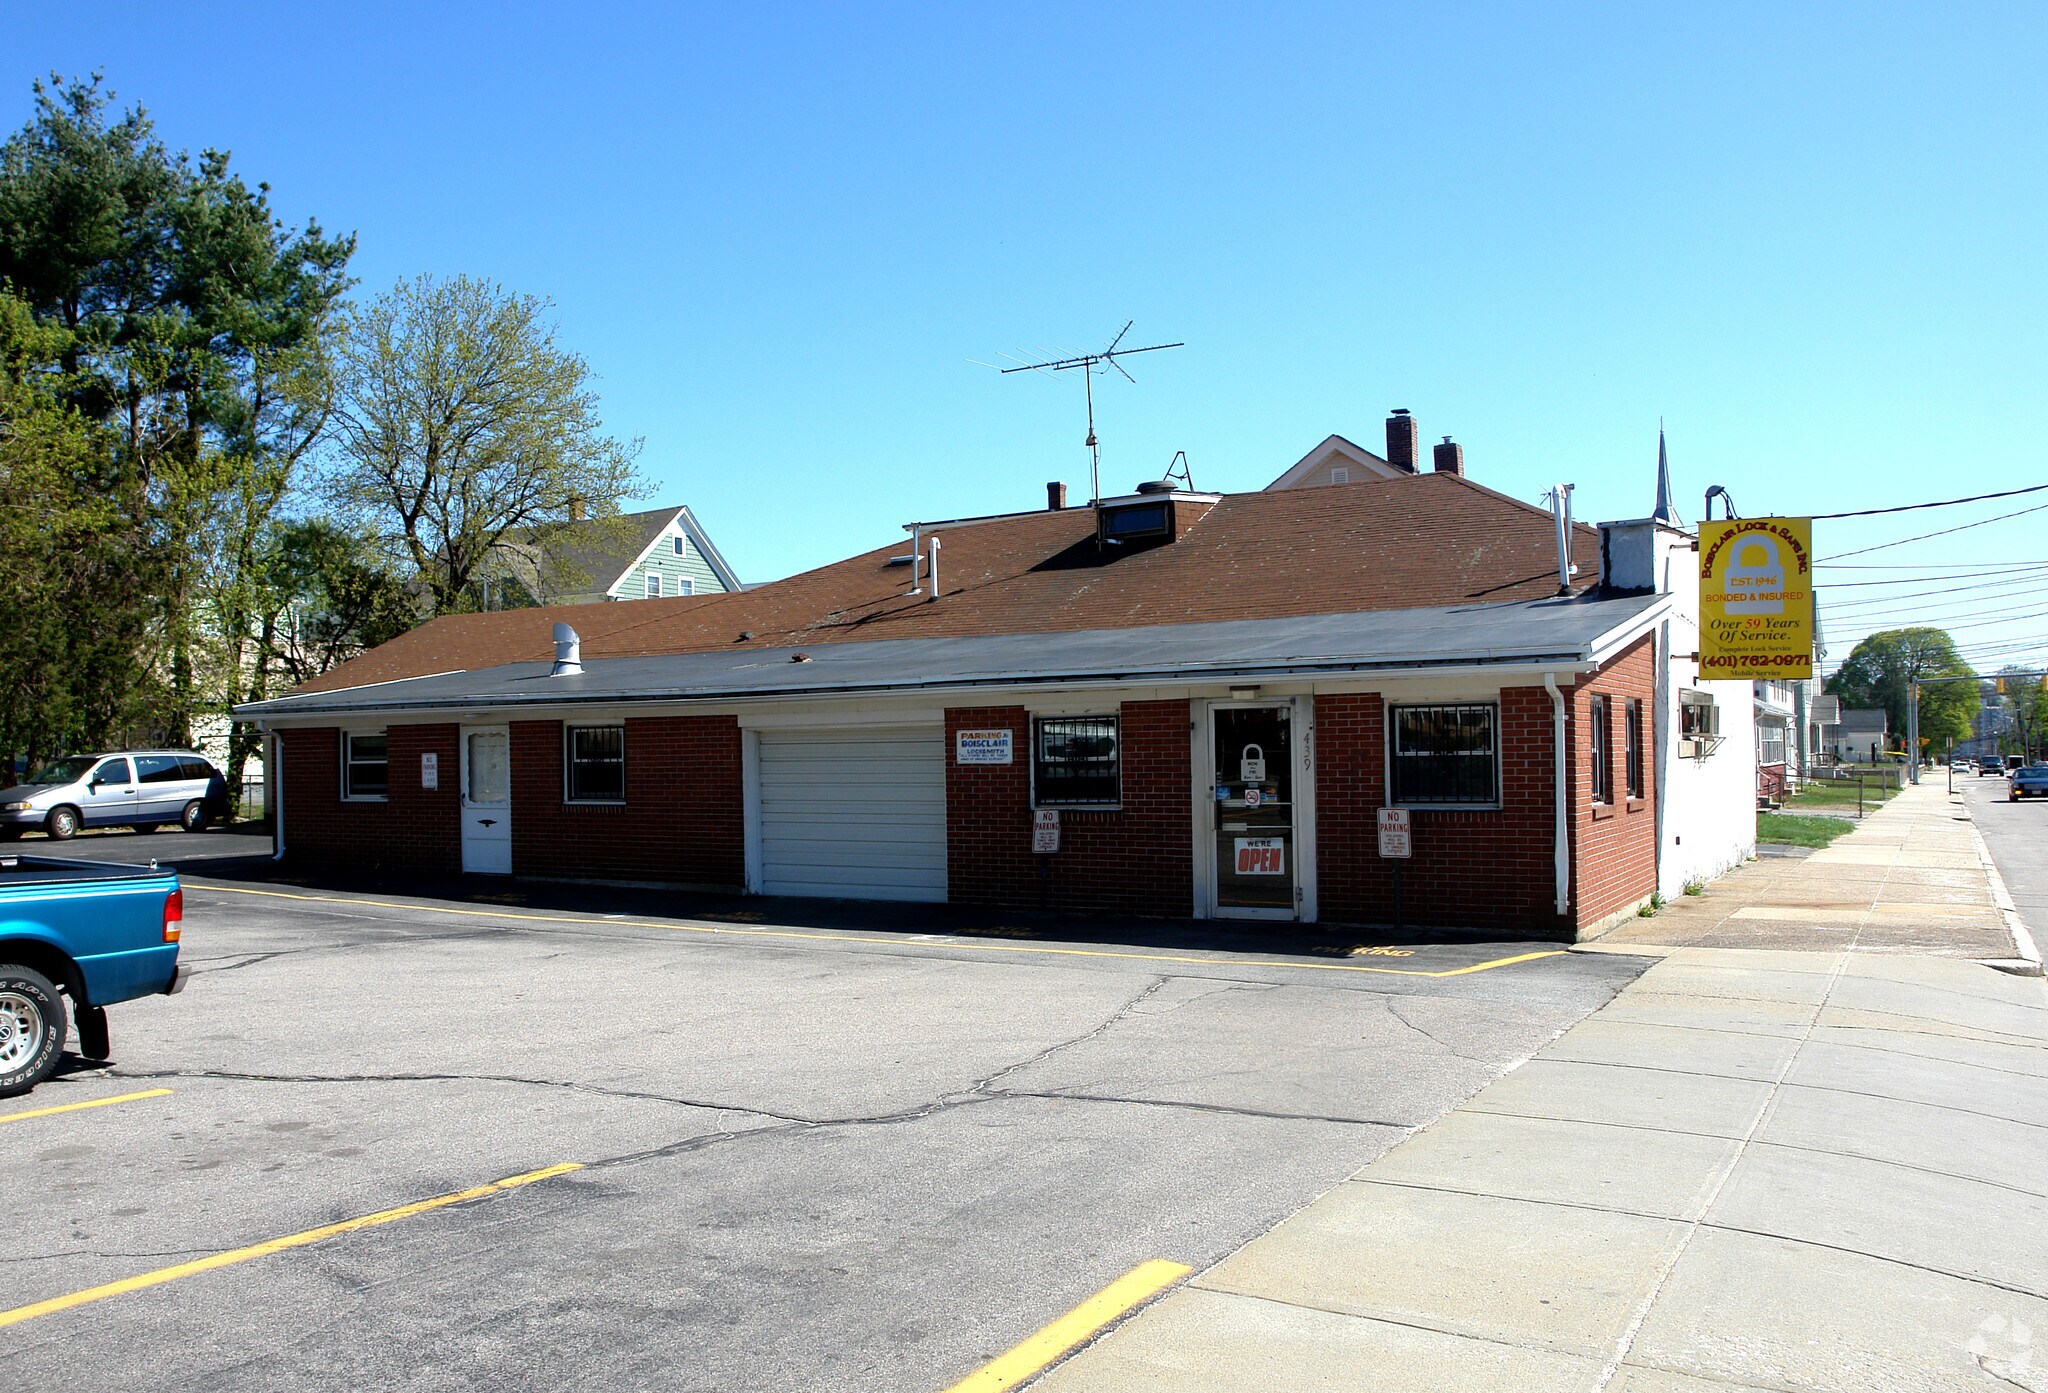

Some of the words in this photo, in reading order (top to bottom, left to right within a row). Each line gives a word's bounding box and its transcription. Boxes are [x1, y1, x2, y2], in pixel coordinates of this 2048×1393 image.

[1736, 522, 1768, 533] LOCK
[1769, 525, 1777, 533] &
[1778, 528, 1802, 553] SAFE
[1730, 577, 1753, 586] EST.
[1756, 574, 1777, 587] 1946
[1705, 594, 1747, 602] BONDED
[1749, 593, 1756, 601] &
[1759, 592, 1804, 601] INSURED
[1710, 619, 1742, 629] Over
[1745, 618, 1761, 629] 59
[1765, 618, 1800, 628] Years
[1719, 630, 1738, 643] Of
[1740, 630, 1791, 641] Service.
[1702, 656, 1738, 669] (401)
[1739, 655, 1811, 667] 762-0971
[961, 732, 1002, 740] PARKING
[961, 740, 1008, 748] BOISCLAIR
[1042, 812, 1053, 821] NO
[1387, 812, 1399, 822] NO
[1034, 822, 1061, 831] PARKING
[1380, 823, 1408, 832] PARKING
[1238, 848, 1281, 872] OPEN
